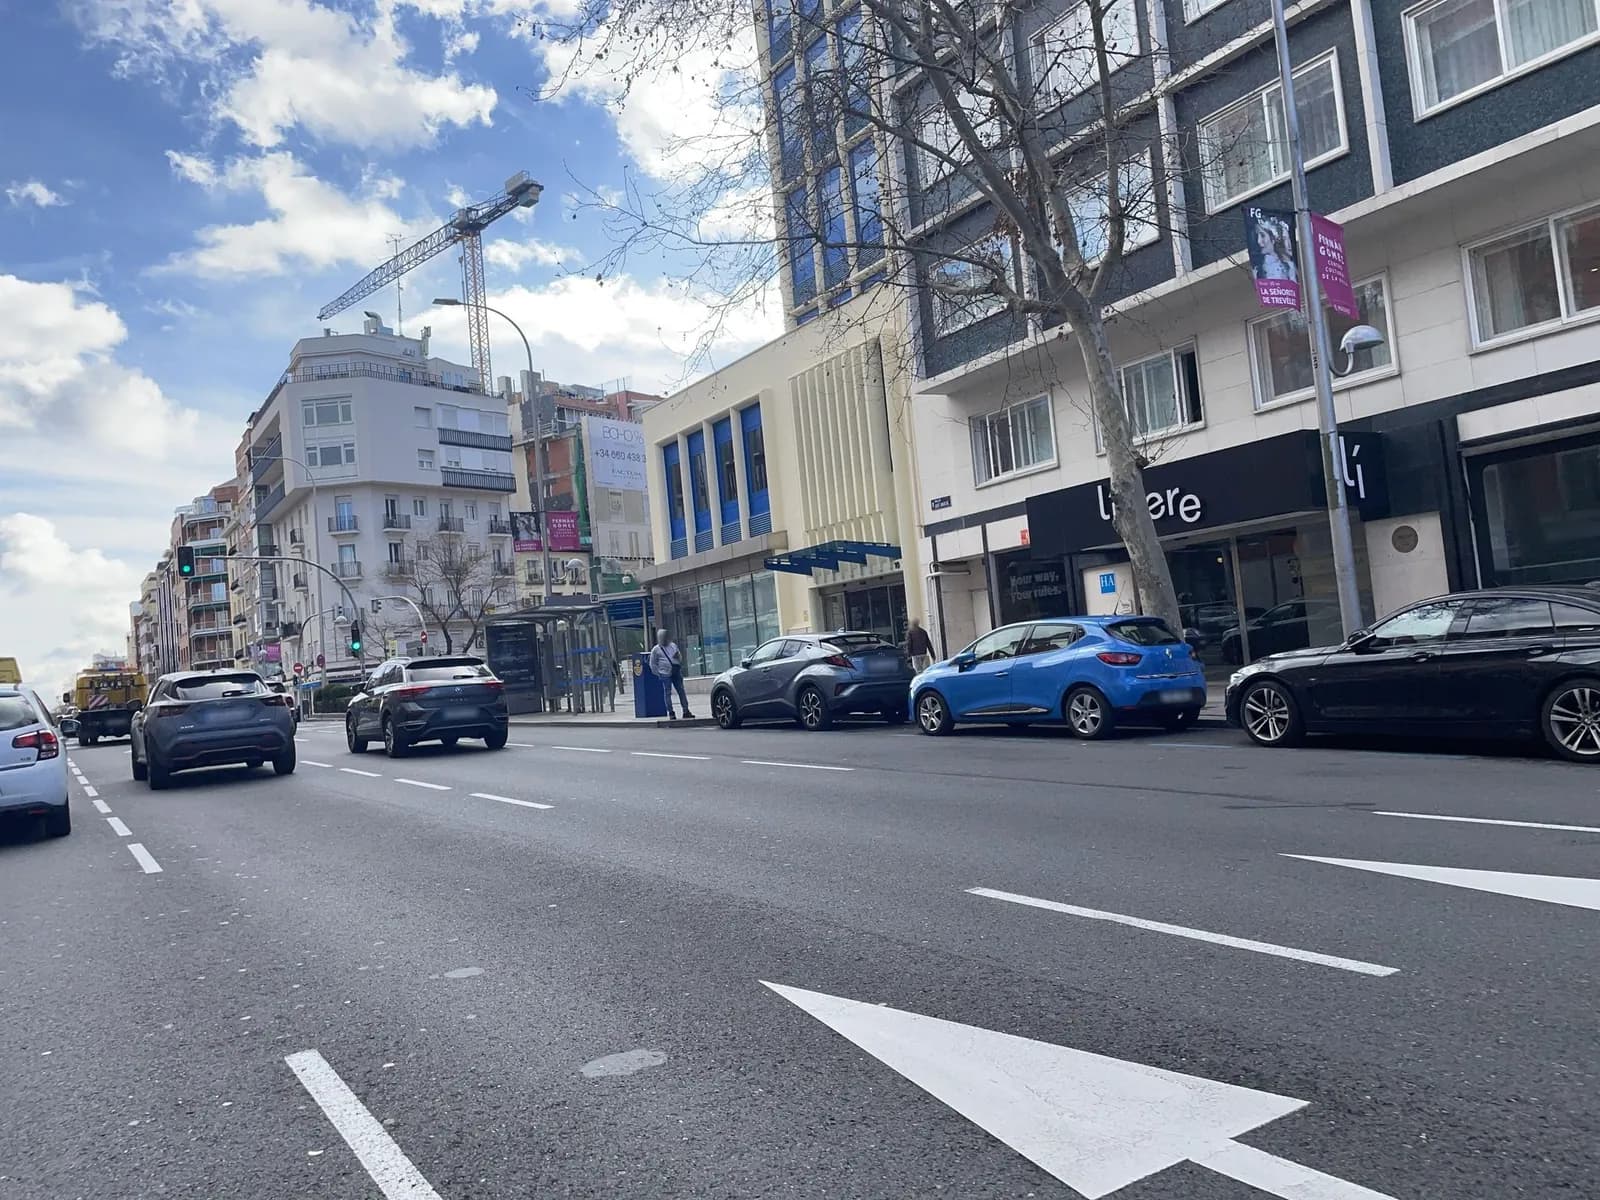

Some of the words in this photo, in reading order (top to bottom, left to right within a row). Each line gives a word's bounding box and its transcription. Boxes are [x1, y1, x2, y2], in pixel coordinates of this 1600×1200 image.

[1250, 207, 1262, 219] FG
[1260, 287, 1269, 296] LA
[1101, 575, 1115, 588] HA
